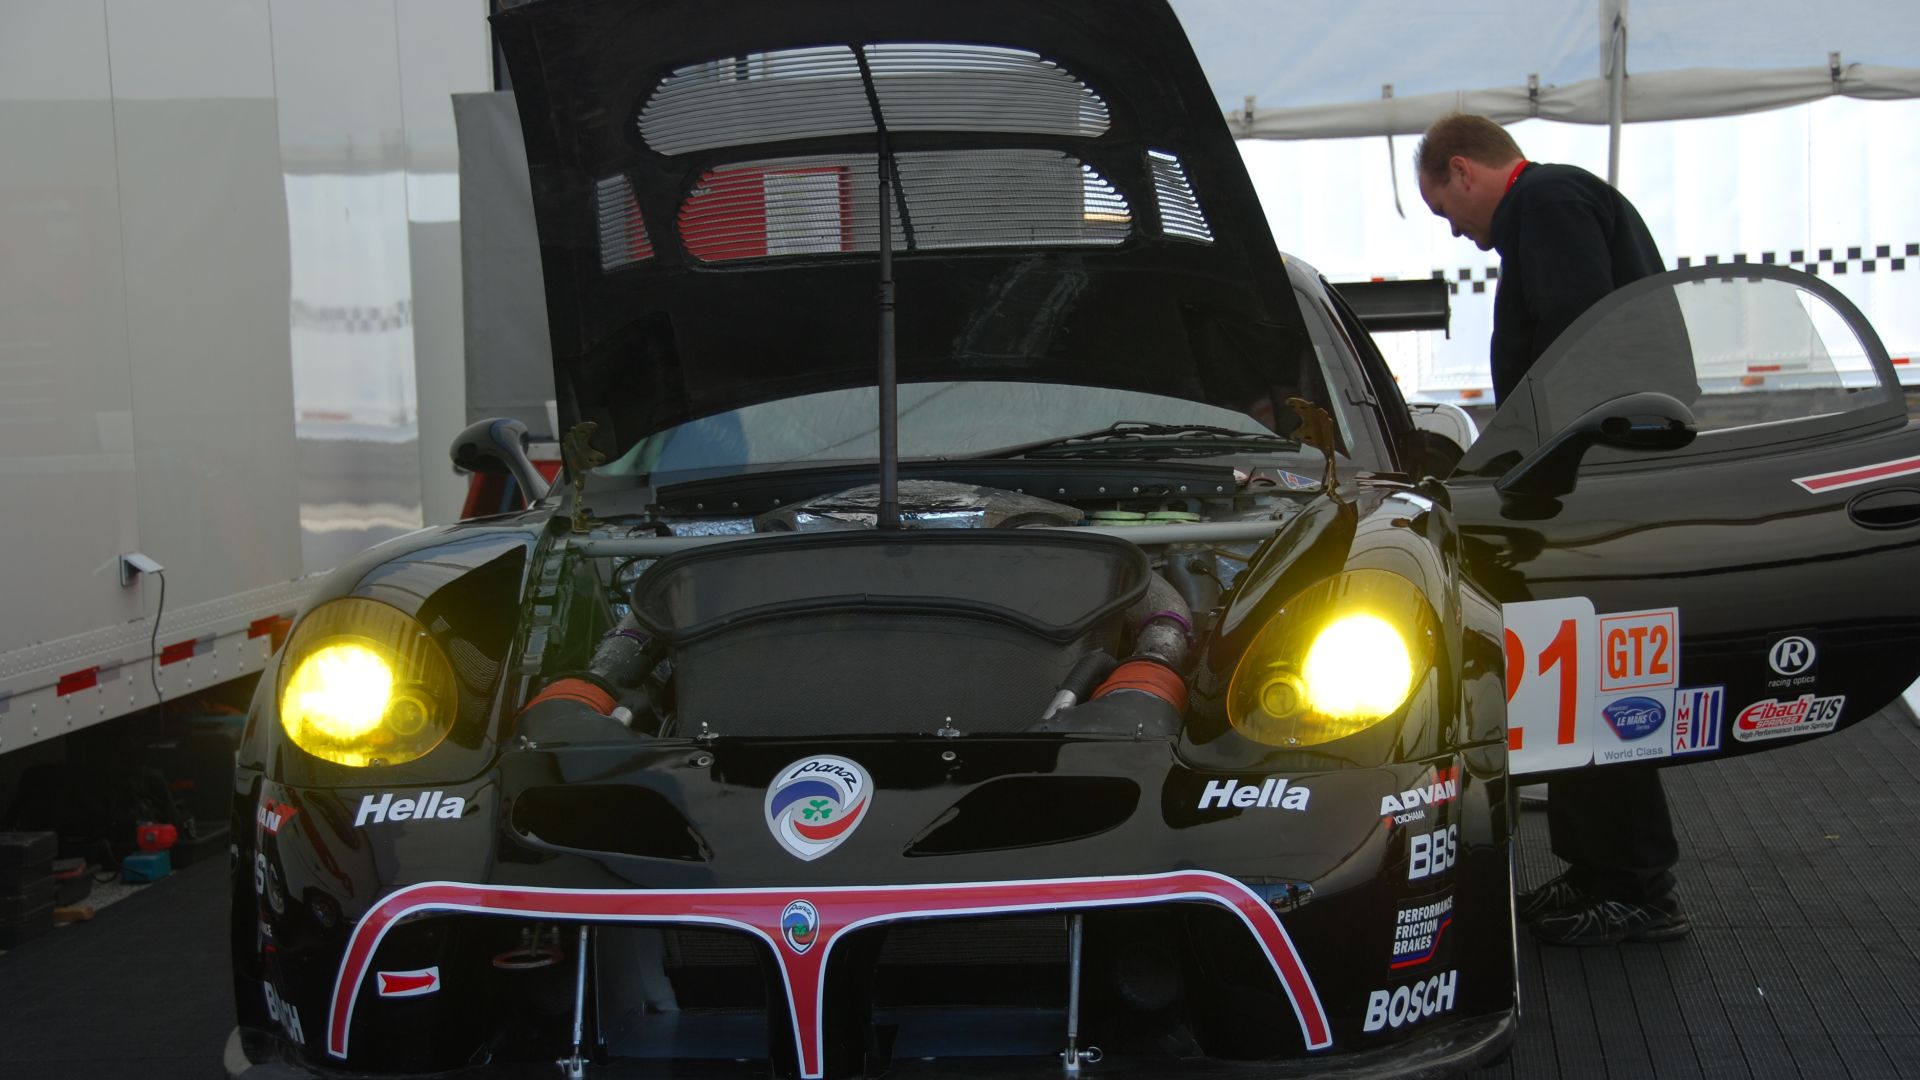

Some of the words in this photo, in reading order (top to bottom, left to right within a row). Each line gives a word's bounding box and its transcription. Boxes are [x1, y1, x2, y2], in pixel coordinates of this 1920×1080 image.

[1607, 625, 1668, 680] GT2
[1768, 678, 1791, 687] racing
[1793, 675, 1815, 686] optics
[1616, 716, 1626, 727] LE
[1627, 714, 1648, 726] MANS
[1738, 698, 1809, 731] Eibach
[1804, 698, 1842, 722] EVS
[1740, 731, 1753, 739] High
[1754, 727, 1792, 736] Performance
[1810, 722, 1834, 731] Springs
[1604, 748, 1633, 760] World
[1636, 747, 1664, 757] Class
[355, 791, 466, 827] Hella
[1197, 779, 1311, 811] Hella
[1380, 779, 1456, 816] ADVAN
[1393, 810, 1425, 824] YOKOHAMA
[1408, 824, 1457, 880] BBS
[1397, 895, 1453, 924] PERFORMANCE
[1395, 918, 1438, 940] FRICTION
[1393, 934, 1432, 955] BRAKES
[1363, 970, 1457, 1032] BOSCH
